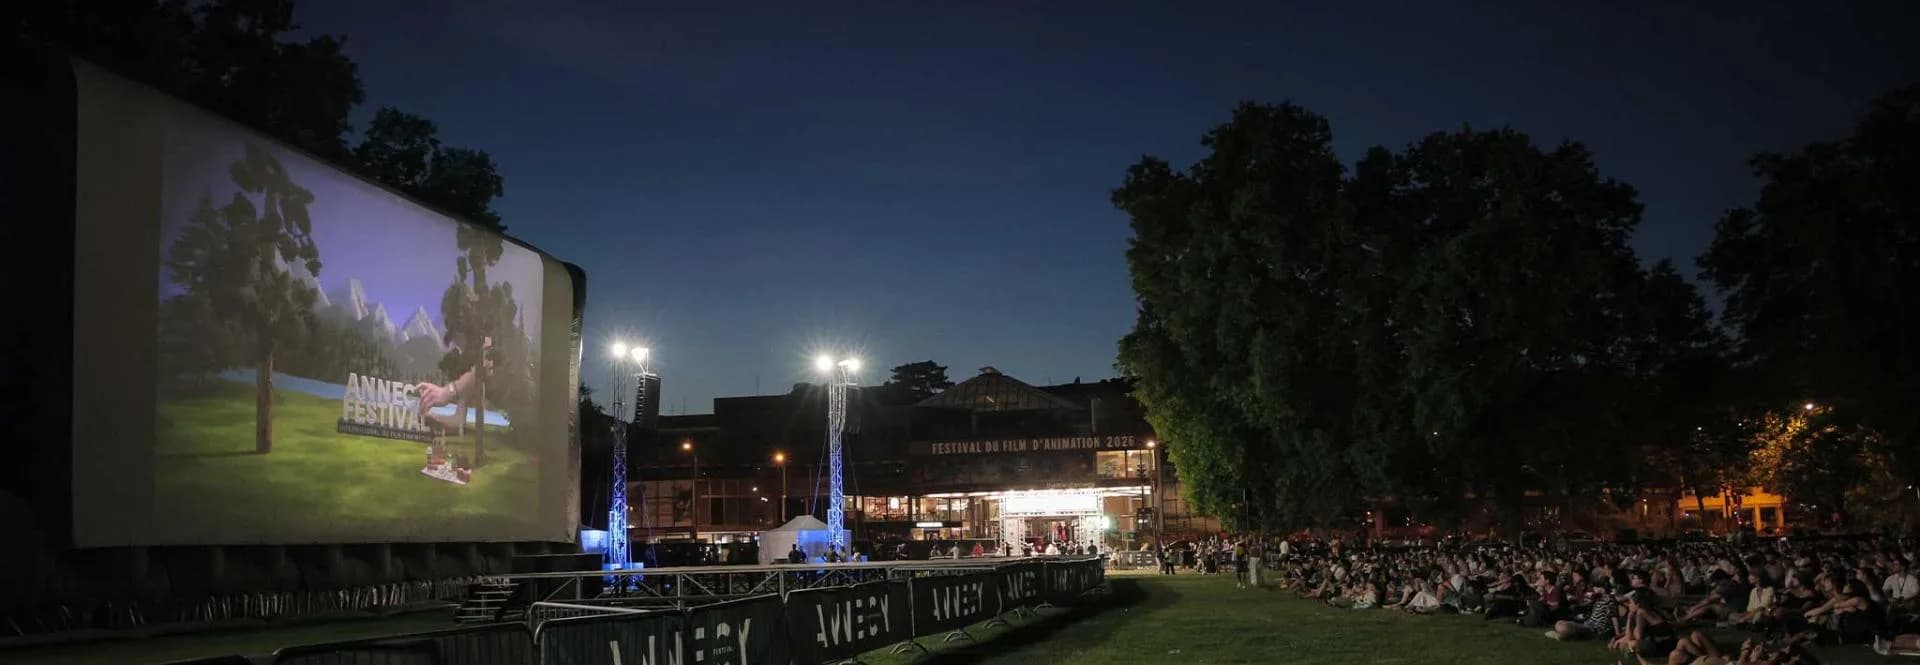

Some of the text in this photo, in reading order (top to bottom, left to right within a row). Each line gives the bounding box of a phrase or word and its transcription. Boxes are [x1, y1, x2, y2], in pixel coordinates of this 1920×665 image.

[346, 372, 418, 408] ANNEC
[343, 396, 430, 433] FESTIVAL
[931, 441, 982, 455] FESTIVAL
[985, 440, 999, 452] DU
[1003, 439, 1027, 452] FILM
[1032, 436, 1100, 451] D'ANIMATION
[816, 594, 890, 648] ANNECY
